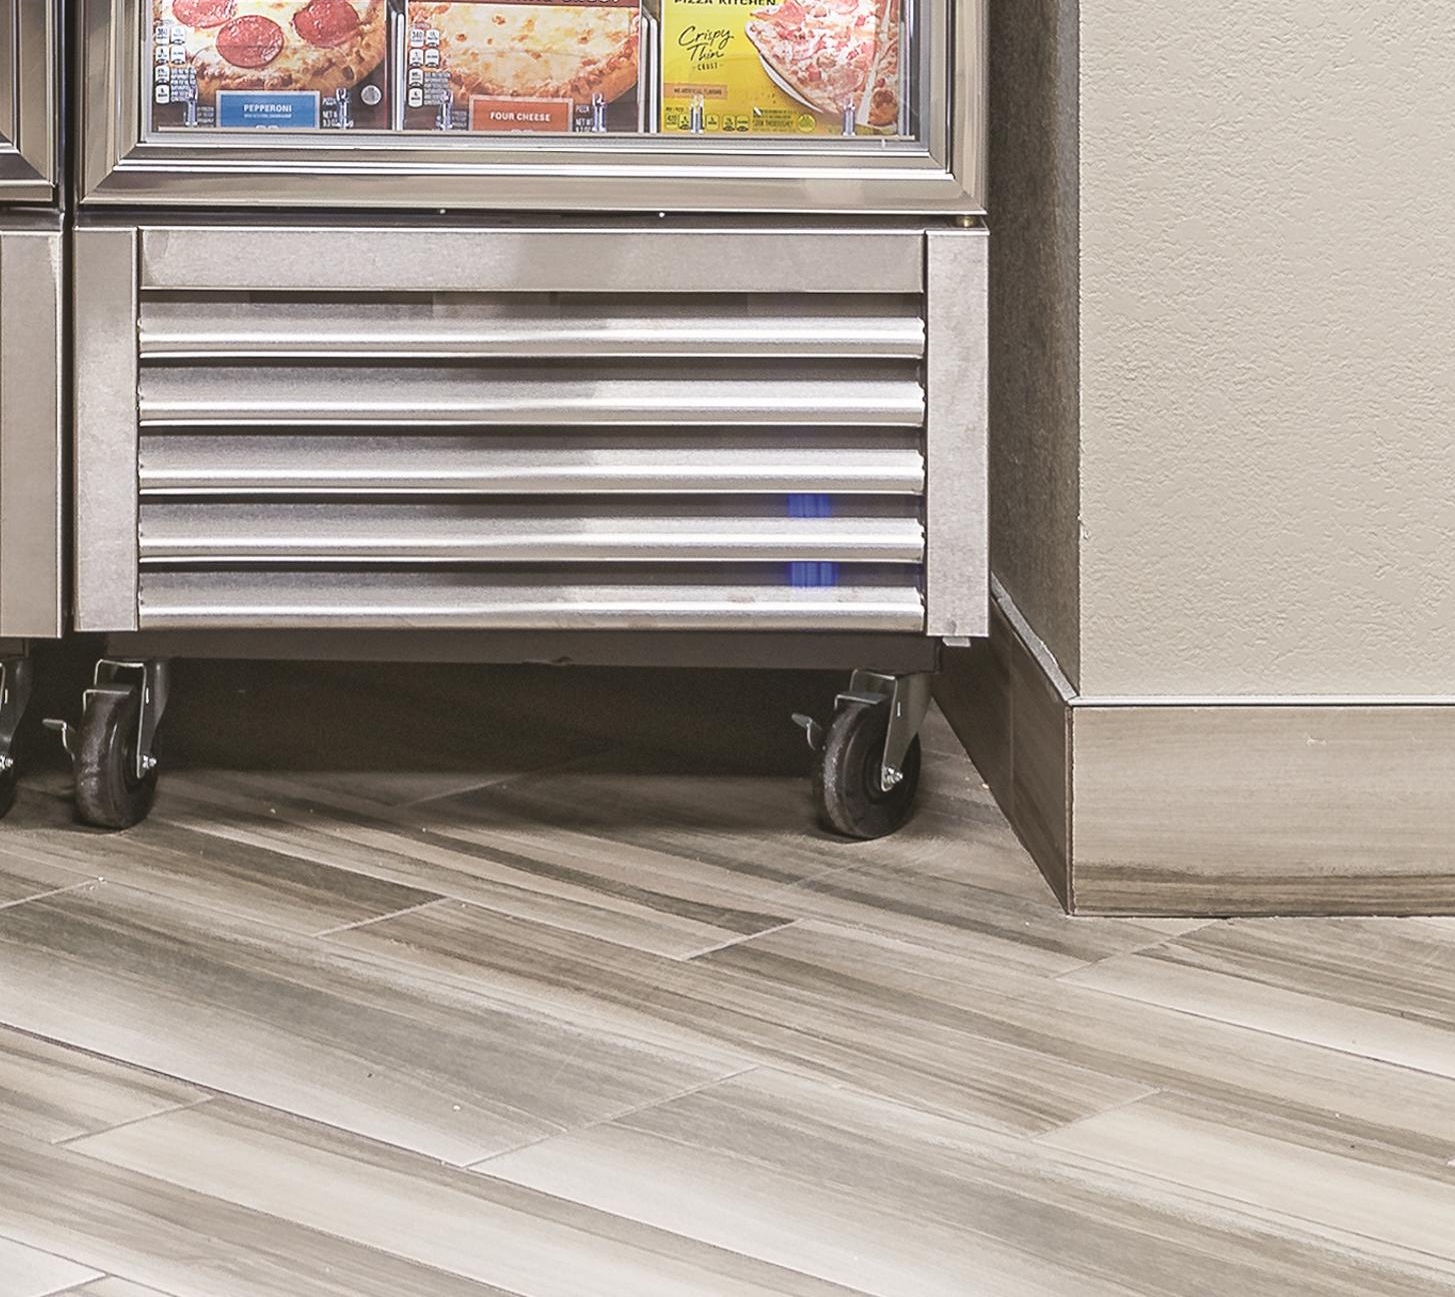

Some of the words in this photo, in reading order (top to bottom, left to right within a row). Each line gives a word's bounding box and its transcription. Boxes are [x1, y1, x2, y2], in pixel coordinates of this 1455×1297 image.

[678, 25, 735, 54] Crispy
[687, 41, 724, 62] Thin
[243, 104, 292, 113] PEPPERONI
[490, 111, 515, 122] FOUR
[517, 112, 551, 123] CHEESE
